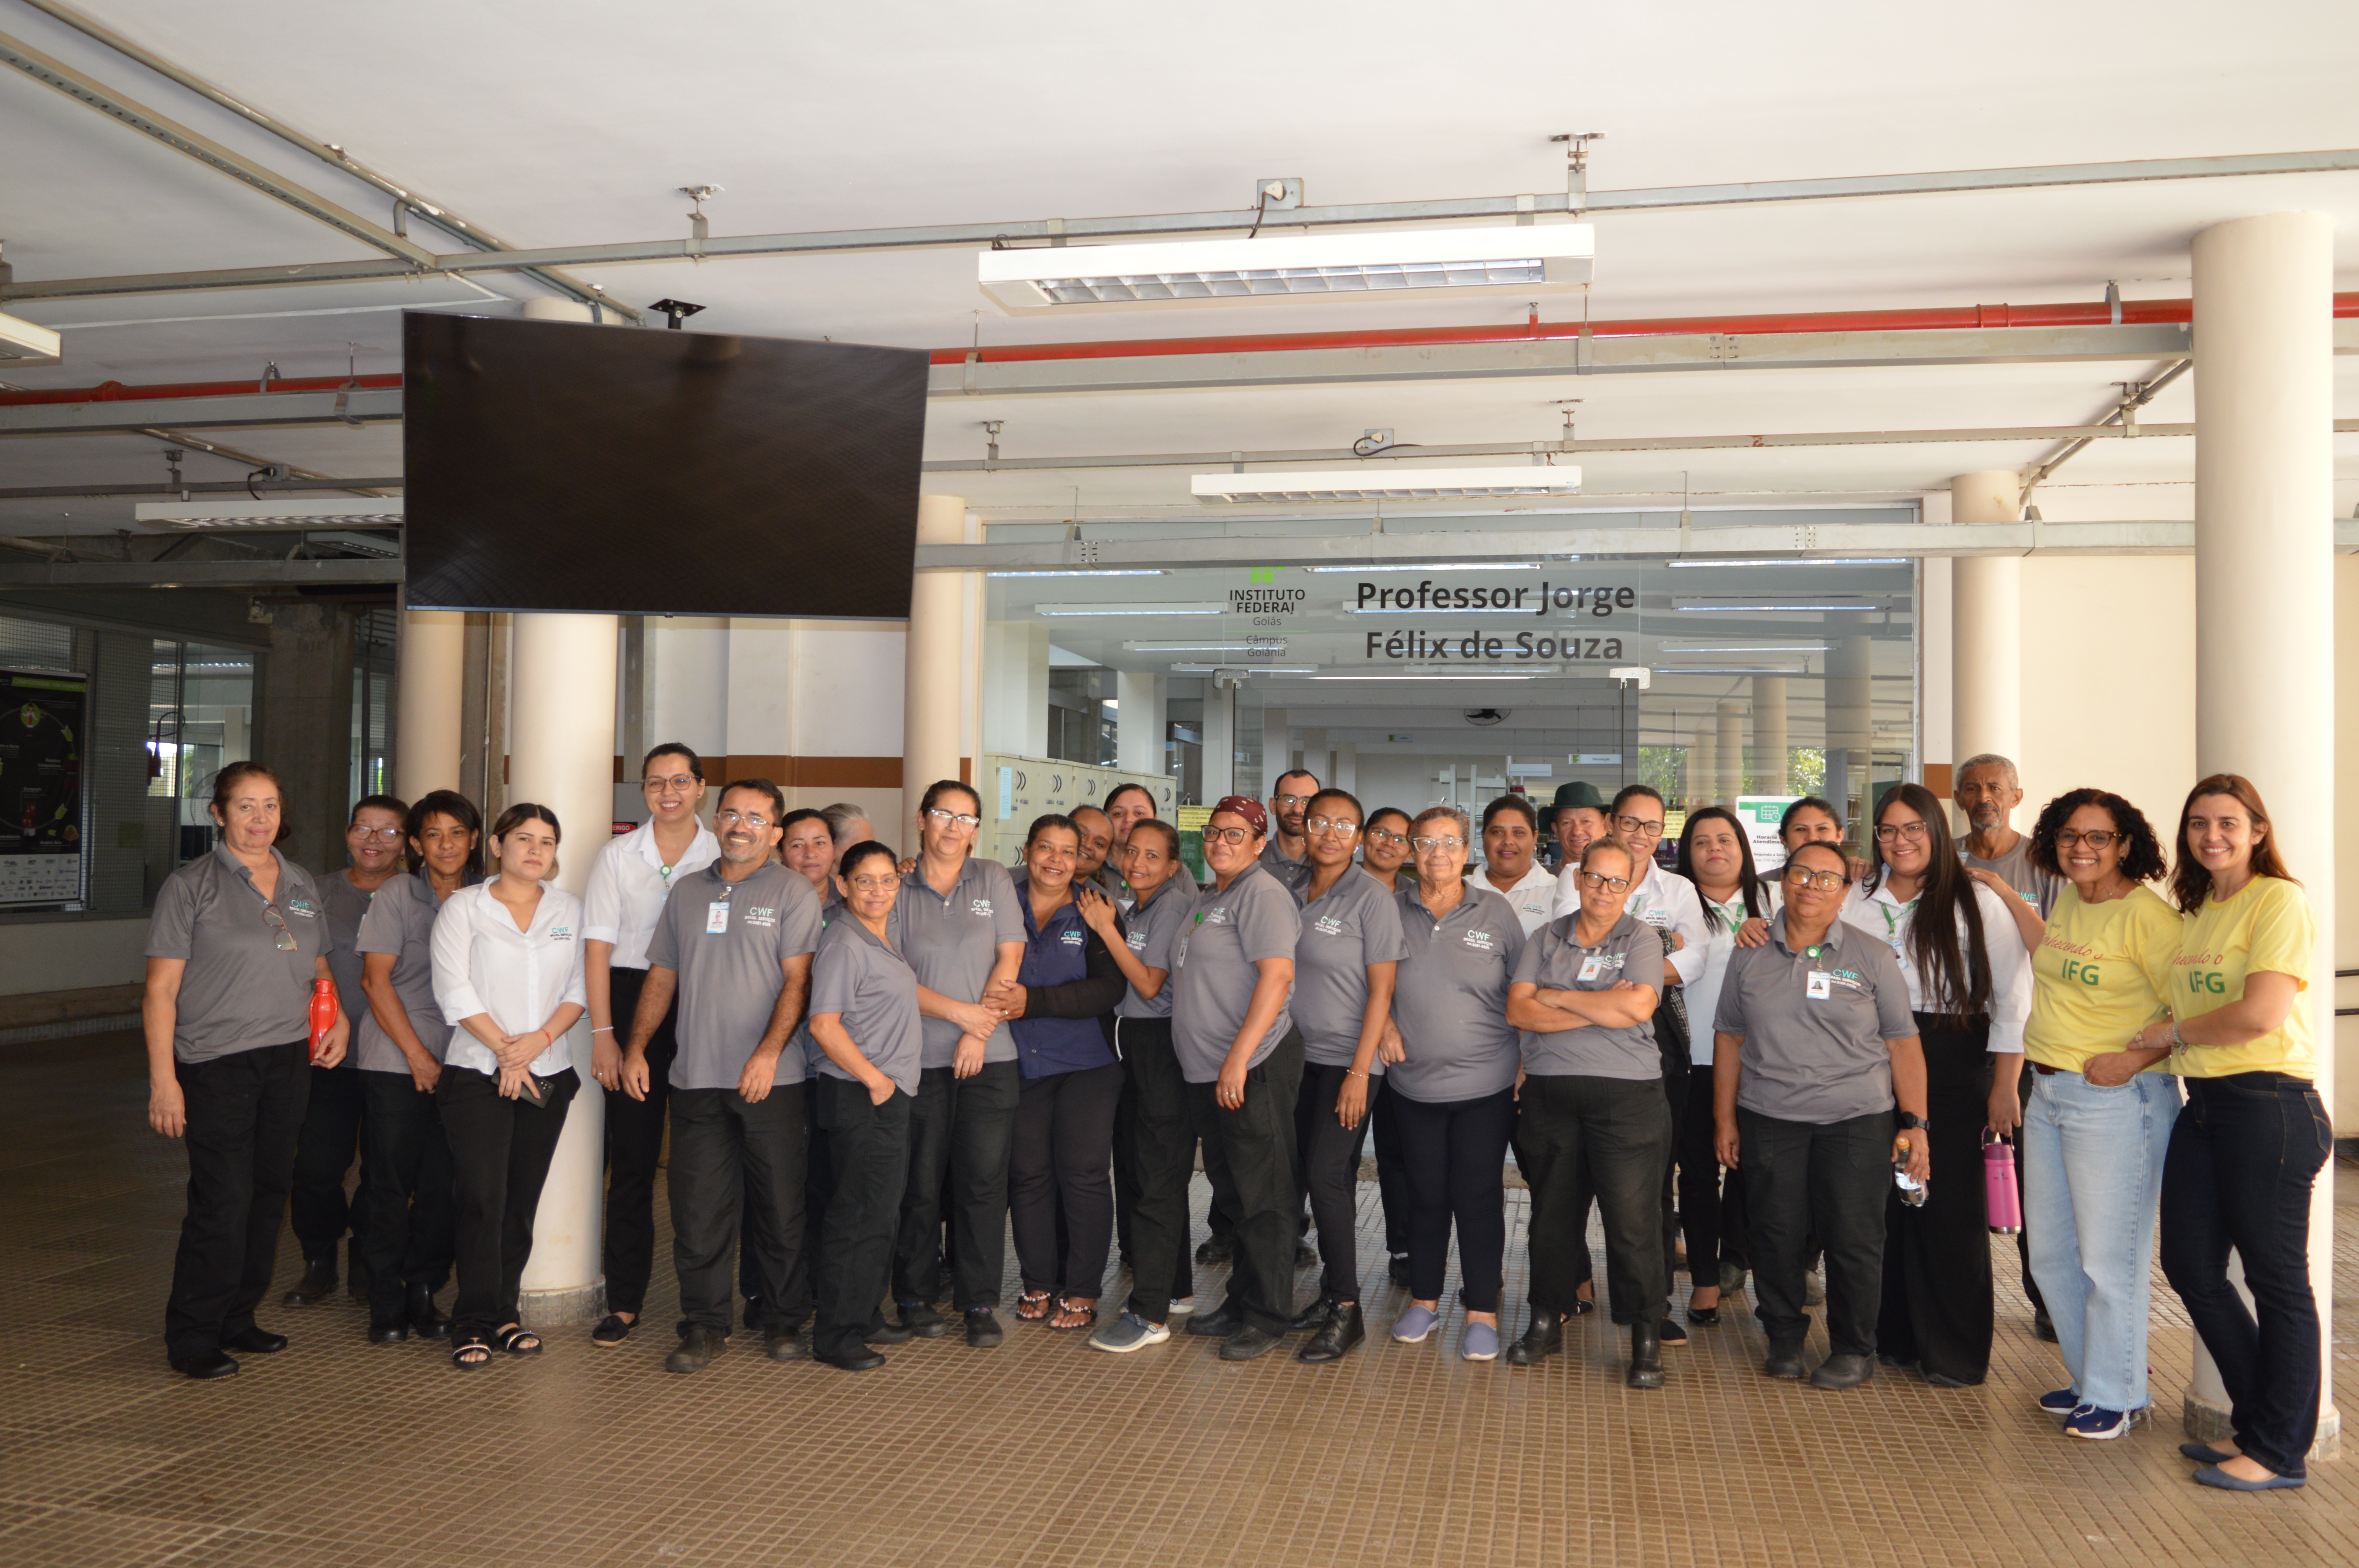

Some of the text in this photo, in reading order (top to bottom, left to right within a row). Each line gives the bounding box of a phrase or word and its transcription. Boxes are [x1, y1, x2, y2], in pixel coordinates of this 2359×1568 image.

[1230, 589, 1306, 601] INSTITUTO
[1358, 581, 1635, 617] Professor Jorge
[1253, 617, 1281, 626] Goiás
[1246, 635, 1288, 646] Câmpus
[1367, 630, 1623, 659] Félix de Souza
[1247, 647, 1286, 657] Goiânia
[291, 899, 309, 909] CWF
[973, 899, 991, 908] CWF
[750, 907, 774, 917] CWF
[1320, 916, 1341, 927] CWF
[1128, 931, 1146, 942] CWF
[1467, 929, 1491, 941] CWF
[2214, 954, 2223, 965] o
[1833, 969, 1859, 979] CWF
[2062, 958, 2100, 986] IFG
[1842, 978, 1861, 987] SERVIÇOS
[2189, 971, 2226, 994] IFG
